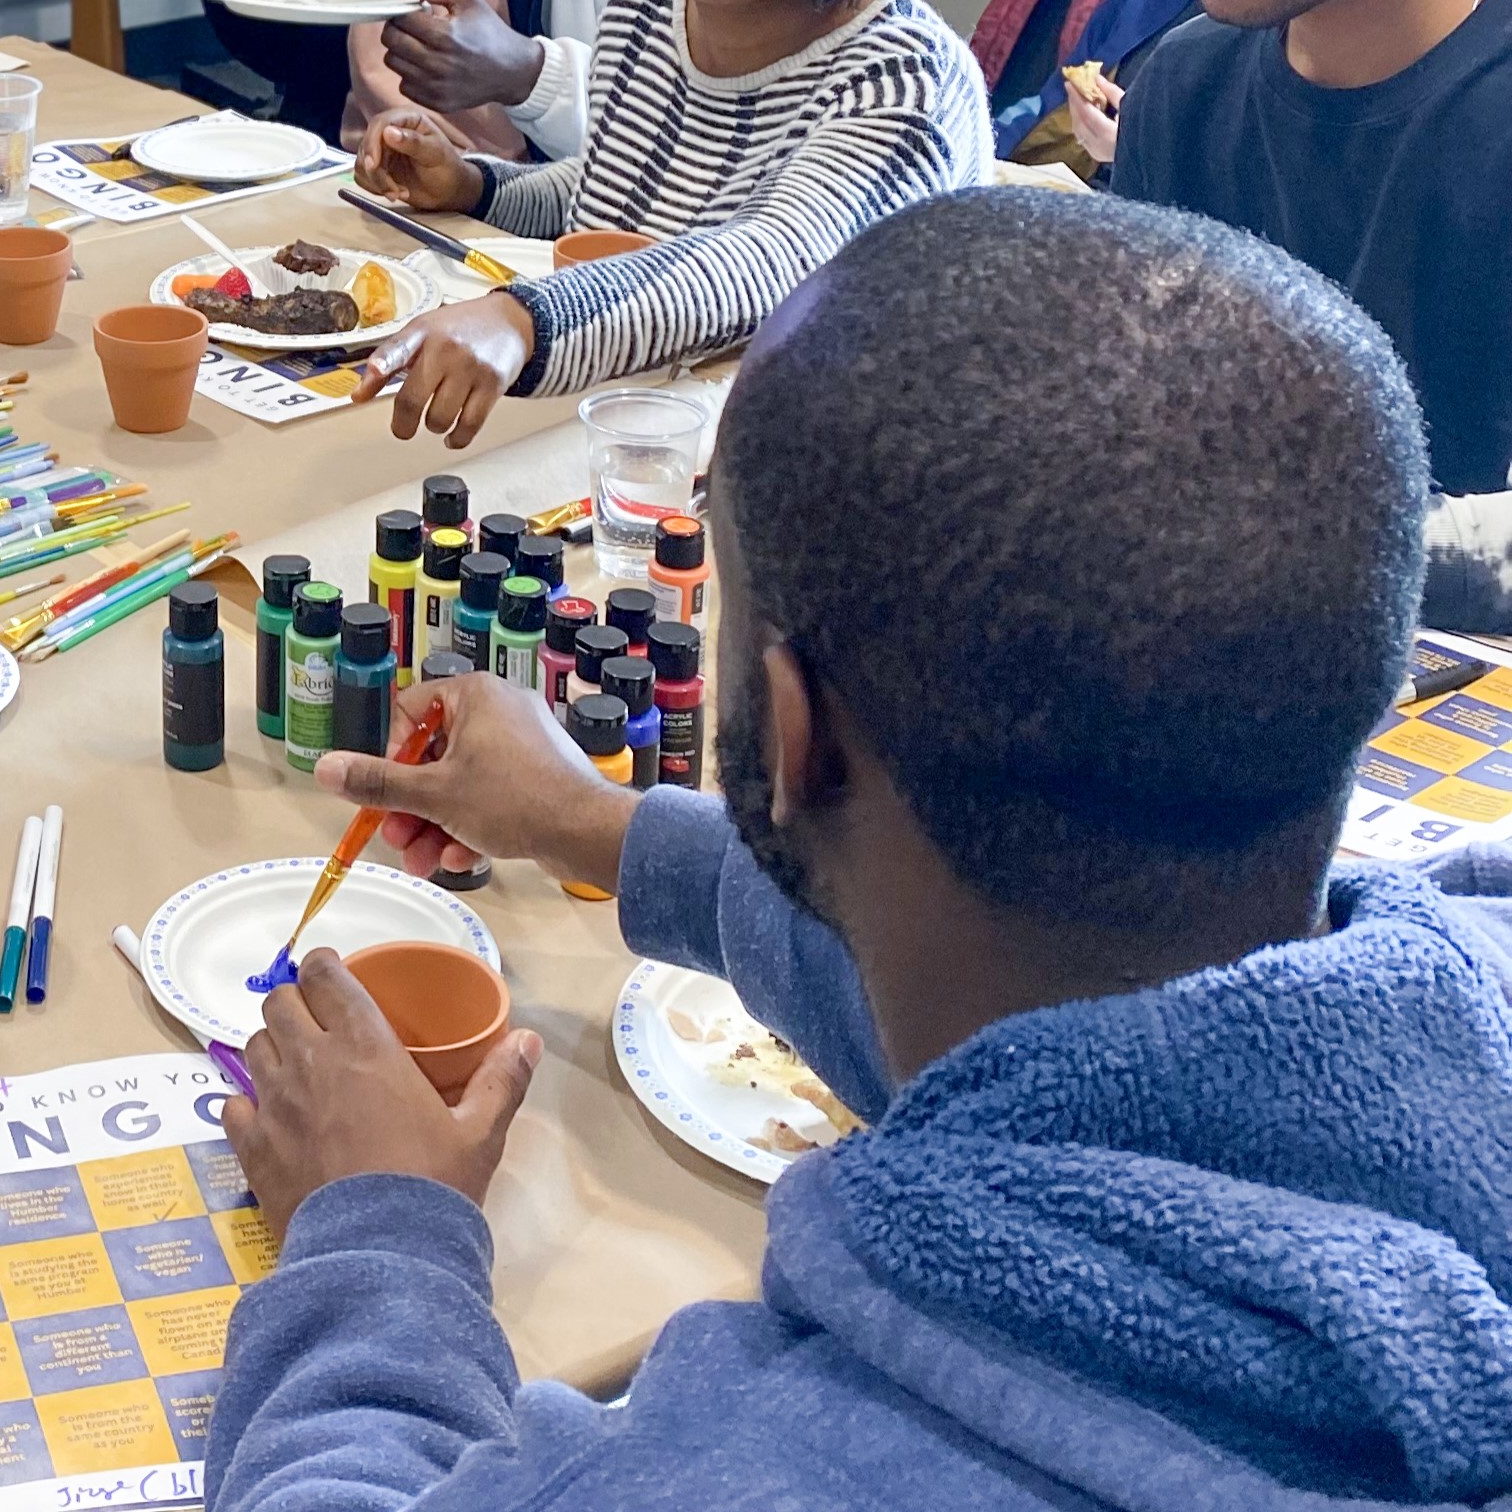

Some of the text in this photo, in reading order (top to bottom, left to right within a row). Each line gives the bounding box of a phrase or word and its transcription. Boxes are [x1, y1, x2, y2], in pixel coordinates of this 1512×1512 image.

[32, 1077, 139, 1109] KNOW
[94, 1169, 148, 1183] Someone
[10, 1205, 58, 1217] Humber
[8, 1212, 67, 1226] residence
[135, 1239, 192, 1254] Someone
[9, 1256, 65, 1268] Someone
[23, 1262, 75, 1275] studying
[14, 1276, 45, 1286] same
[37, 1287, 87, 1300] Humber
[144, 1304, 203, 1319] Someone
[33, 1328, 92, 1343] Someone
[66, 1336, 97, 1346] from
[55, 1342, 111, 1358] different
[171, 1340, 216, 1352] coming
[39, 1349, 133, 1371] continent than
[58, 1409, 119, 1424] Someone
[86, 1418, 118, 1429] from
[66, 1423, 154, 1442] same country
